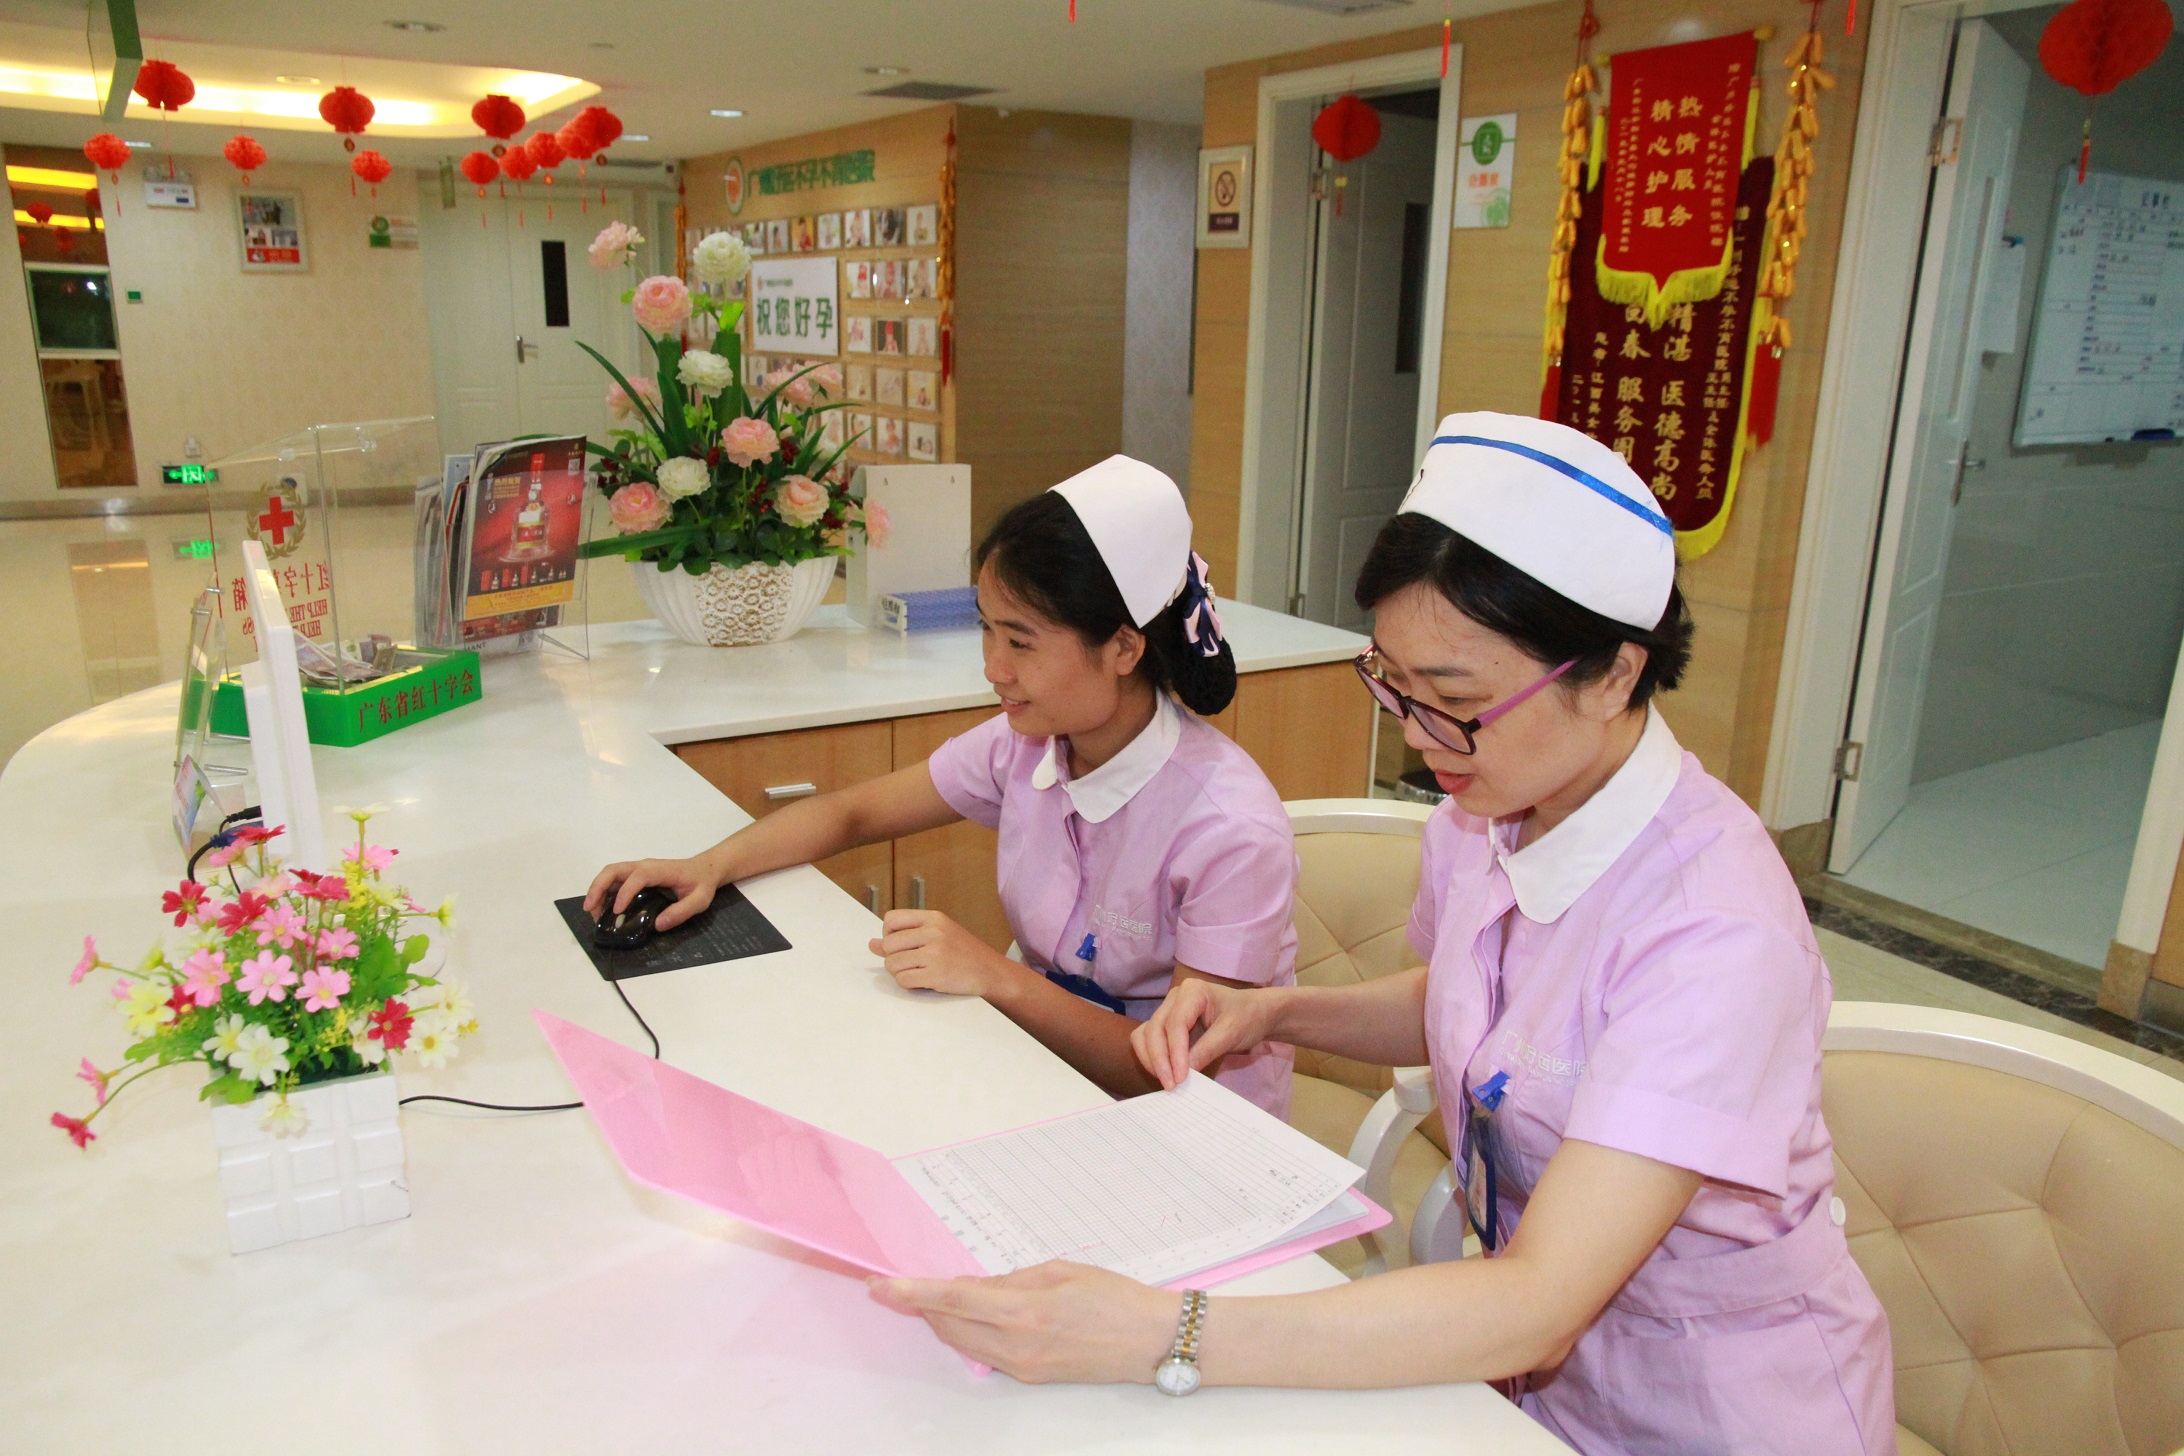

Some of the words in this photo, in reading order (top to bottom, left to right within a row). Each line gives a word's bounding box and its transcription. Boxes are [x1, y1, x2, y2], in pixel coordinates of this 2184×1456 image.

[1641, 98, 1674, 228] 精心护理
[1668, 96, 1703, 228] 热情服务
[756, 297, 833, 339] 祝您好孕
[1650, 380, 1686, 500] 医德高尚
[359, 668, 473, 733] 广东省红十字会
